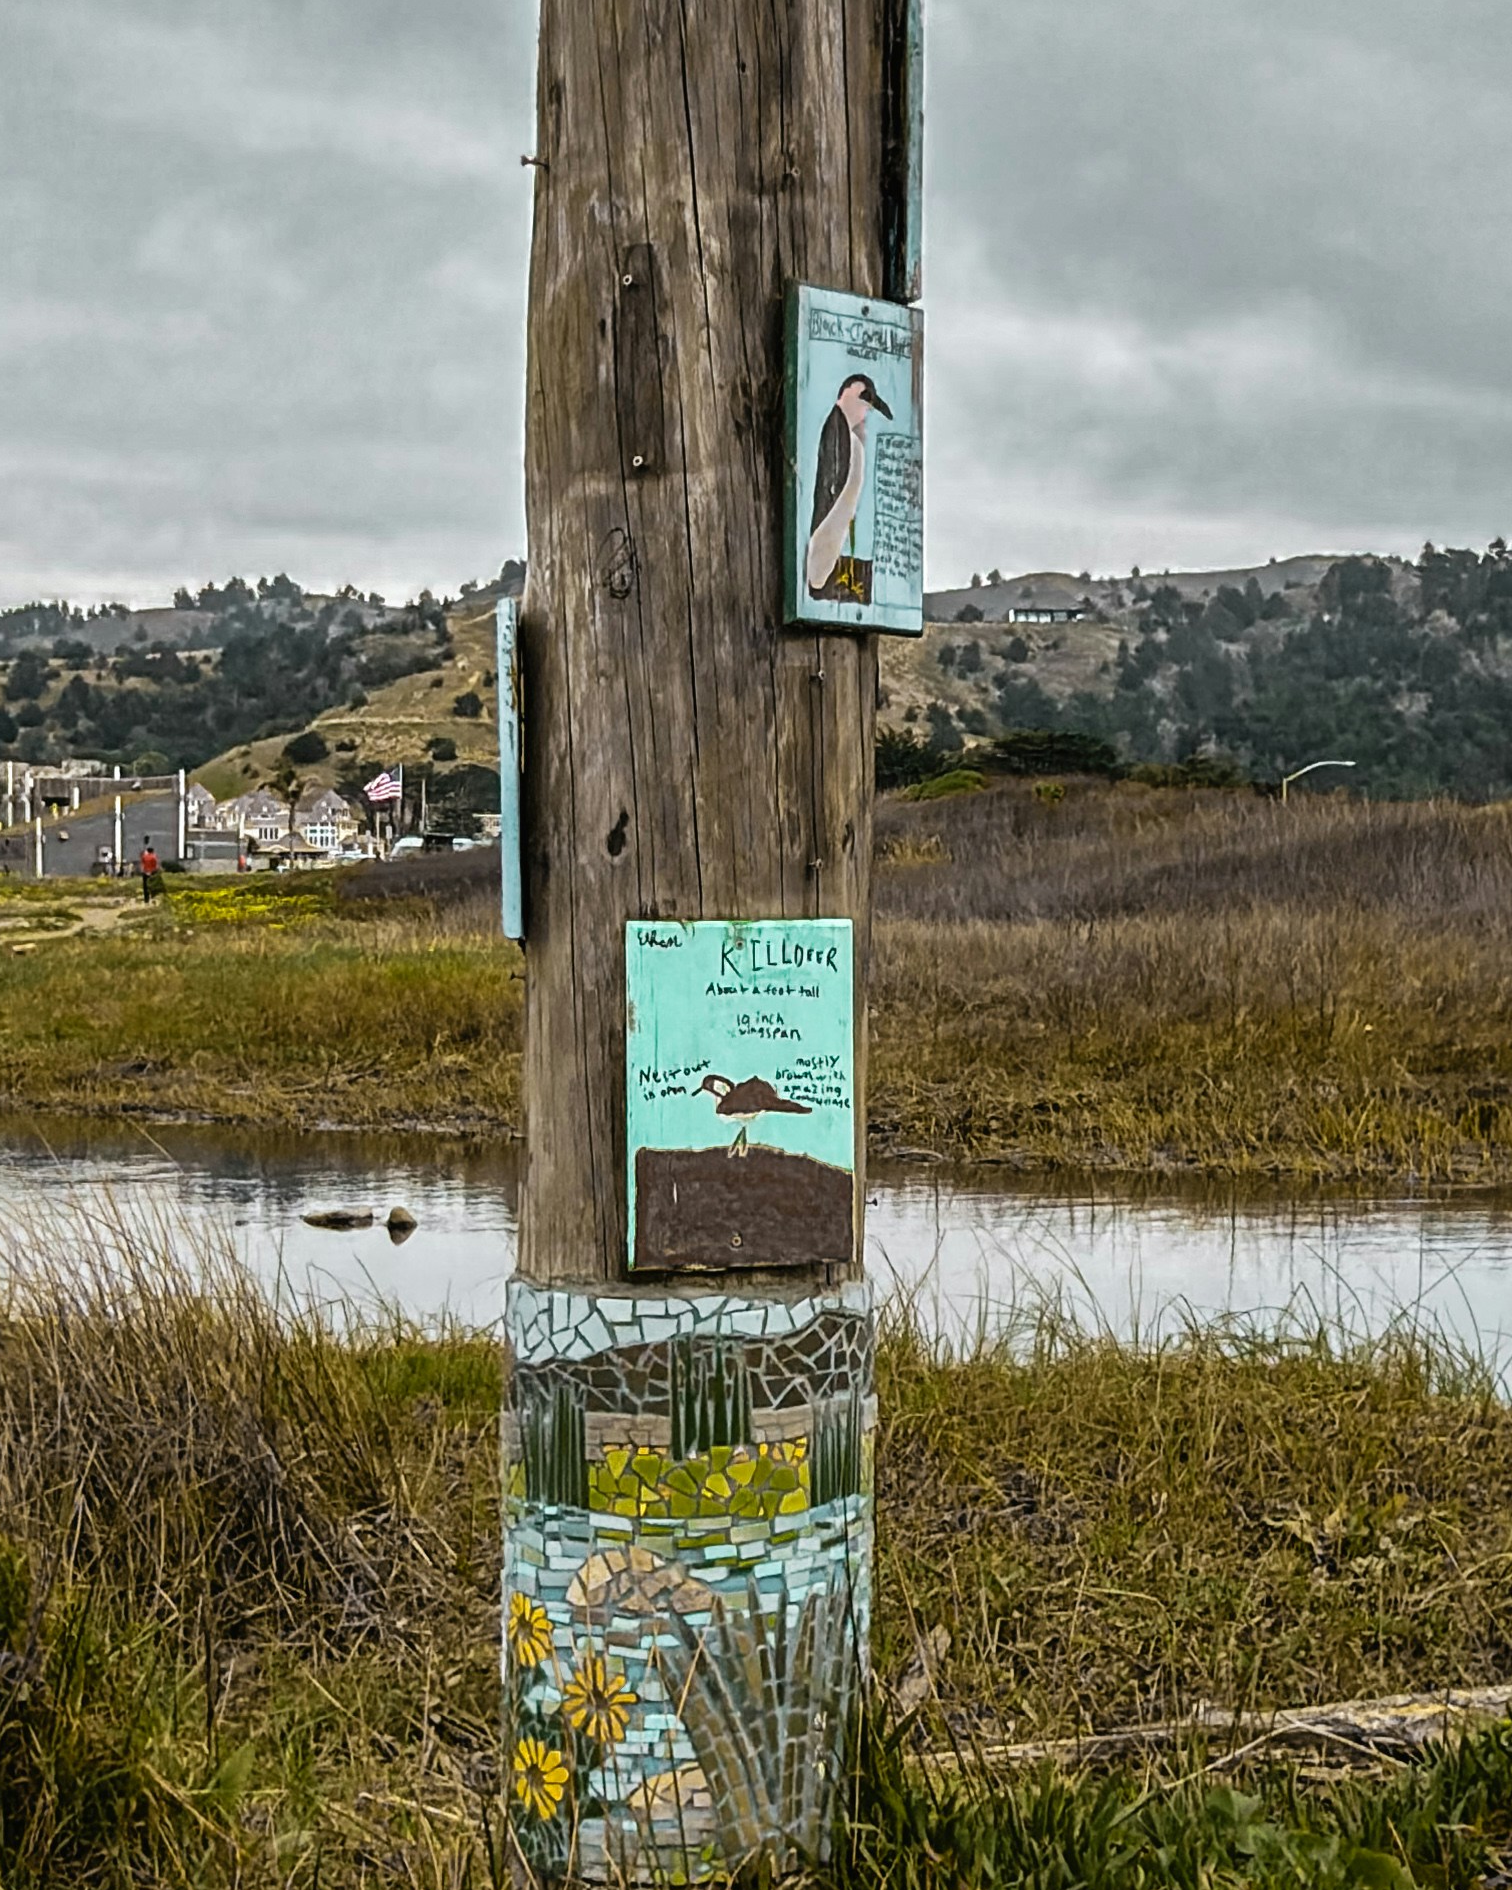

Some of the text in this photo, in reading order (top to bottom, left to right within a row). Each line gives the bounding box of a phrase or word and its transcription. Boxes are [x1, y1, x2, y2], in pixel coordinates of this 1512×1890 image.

[721, 938, 839, 979] KILLDEER
[705, 981, 820, 998] About a foot tall
[755, 1012, 785, 1026] inch
[738, 1026, 803, 1042] wingspan
[795, 1055, 840, 1071] mostly
[775, 1067, 814, 1082] brown
[783, 1083, 843, 1098] amazing
